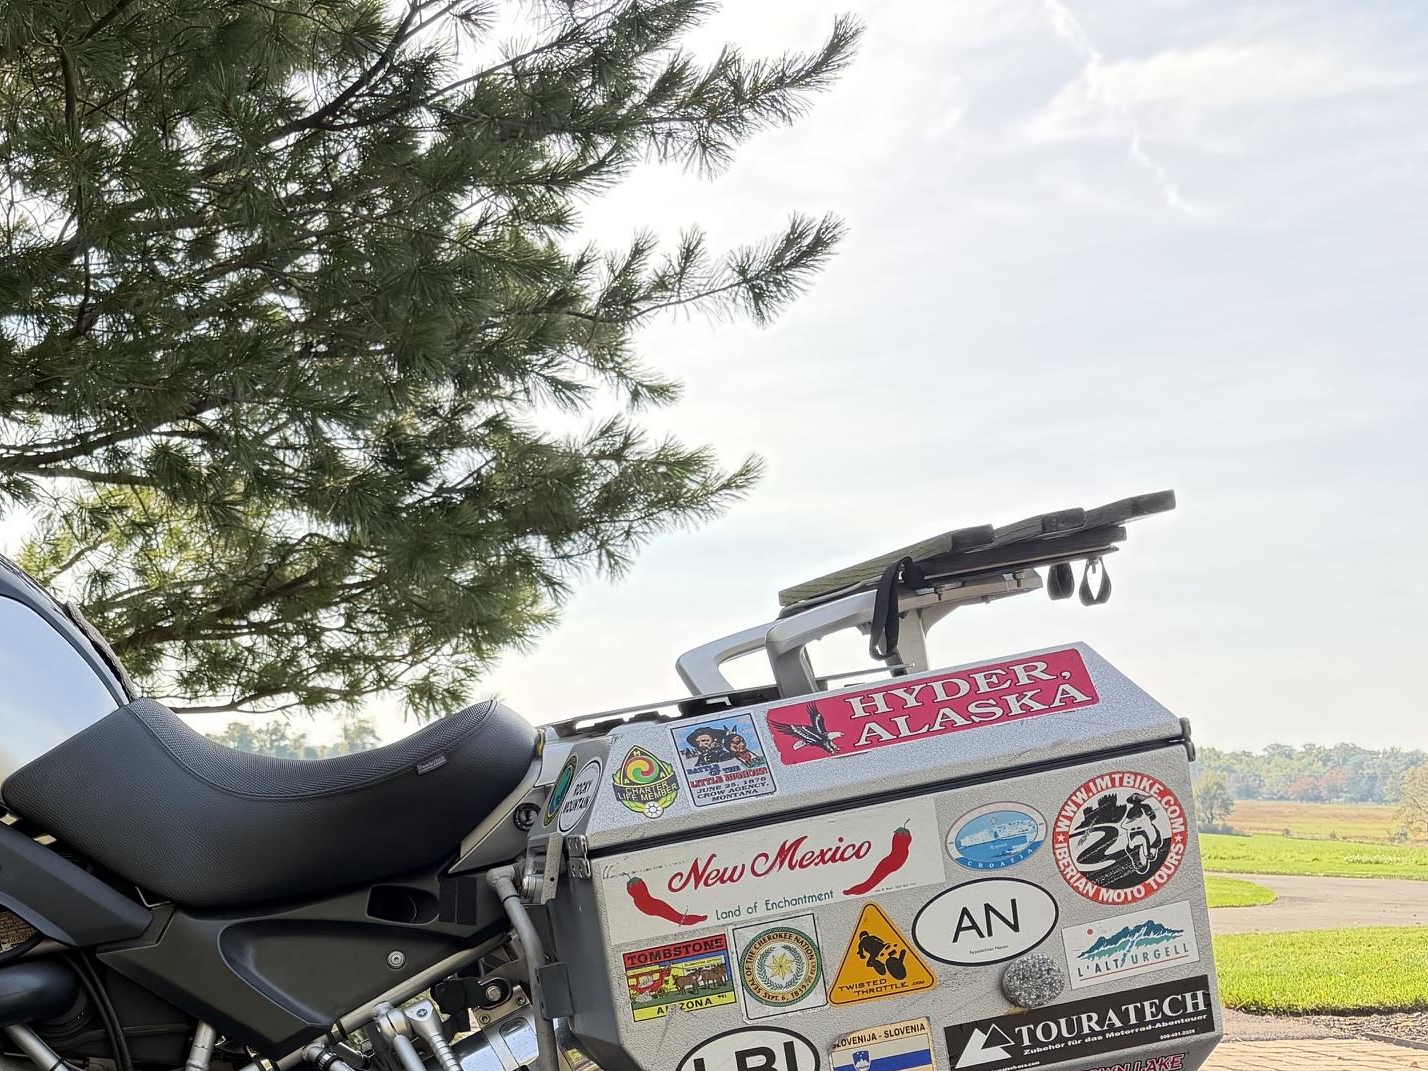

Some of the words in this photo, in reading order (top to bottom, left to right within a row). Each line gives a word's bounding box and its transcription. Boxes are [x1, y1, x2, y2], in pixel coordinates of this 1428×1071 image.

[845, 660, 1072, 719] HYDER,
[854, 683, 1092, 747] ALASKA
[689, 775, 724, 788] LITTLE
[724, 767, 768, 781] BIGHORN
[697, 785, 721, 794] JUNE
[743, 776, 767, 785] 1876
[617, 792, 637, 801] LIFE
[640, 782, 678, 801] MEMBER
[625, 781, 668, 795] CHARTER
[697, 790, 725, 799] CROW
[712, 789, 759, 802] MONTANA
[1055, 773, 1184, 834] WWW.IMTBIKE.COM
[667, 853, 746, 892] New
[750, 835, 872, 878] Mexico
[967, 848, 1033, 869] CROATIA
[1055, 842, 1098, 898] IBERIAN
[1098, 885, 1146, 903] MOTO
[1146, 843, 1184, 890] TOURS
[716, 905, 742, 921] Land
[746, 902, 758, 914] of
[764, 889, 834, 911] Enchantment
[952, 898, 1020, 943] AN
[627, 938, 724, 965] TOMBSTONE
[754, 933, 793, 950] CHEROKEE
[794, 936, 815, 961] NATION
[746, 950, 756, 965] THE
[1077, 959, 1119, 977] L'ALT
[1131, 943, 1188, 965] URGELL
[745, 965, 752, 976] OF
[749, 977, 762, 993] SEAL
[791, 985, 807, 998] 1839
[838, 978, 887, 991] TWISTED
[853, 982, 909, 996] THROTTLE
[656, 998, 712, 1015] AZONA
[1015, 990, 1208, 1046] TOURATECH
[884, 1023, 926, 1039] SLOVENIA
[1023, 1042, 1065, 1055] Zubehör
[1068, 1034, 1082, 1047] für
[1084, 1034, 1103, 1043] das
[1105, 1014, 1207, 1039] Motorrad-Abenteuer
